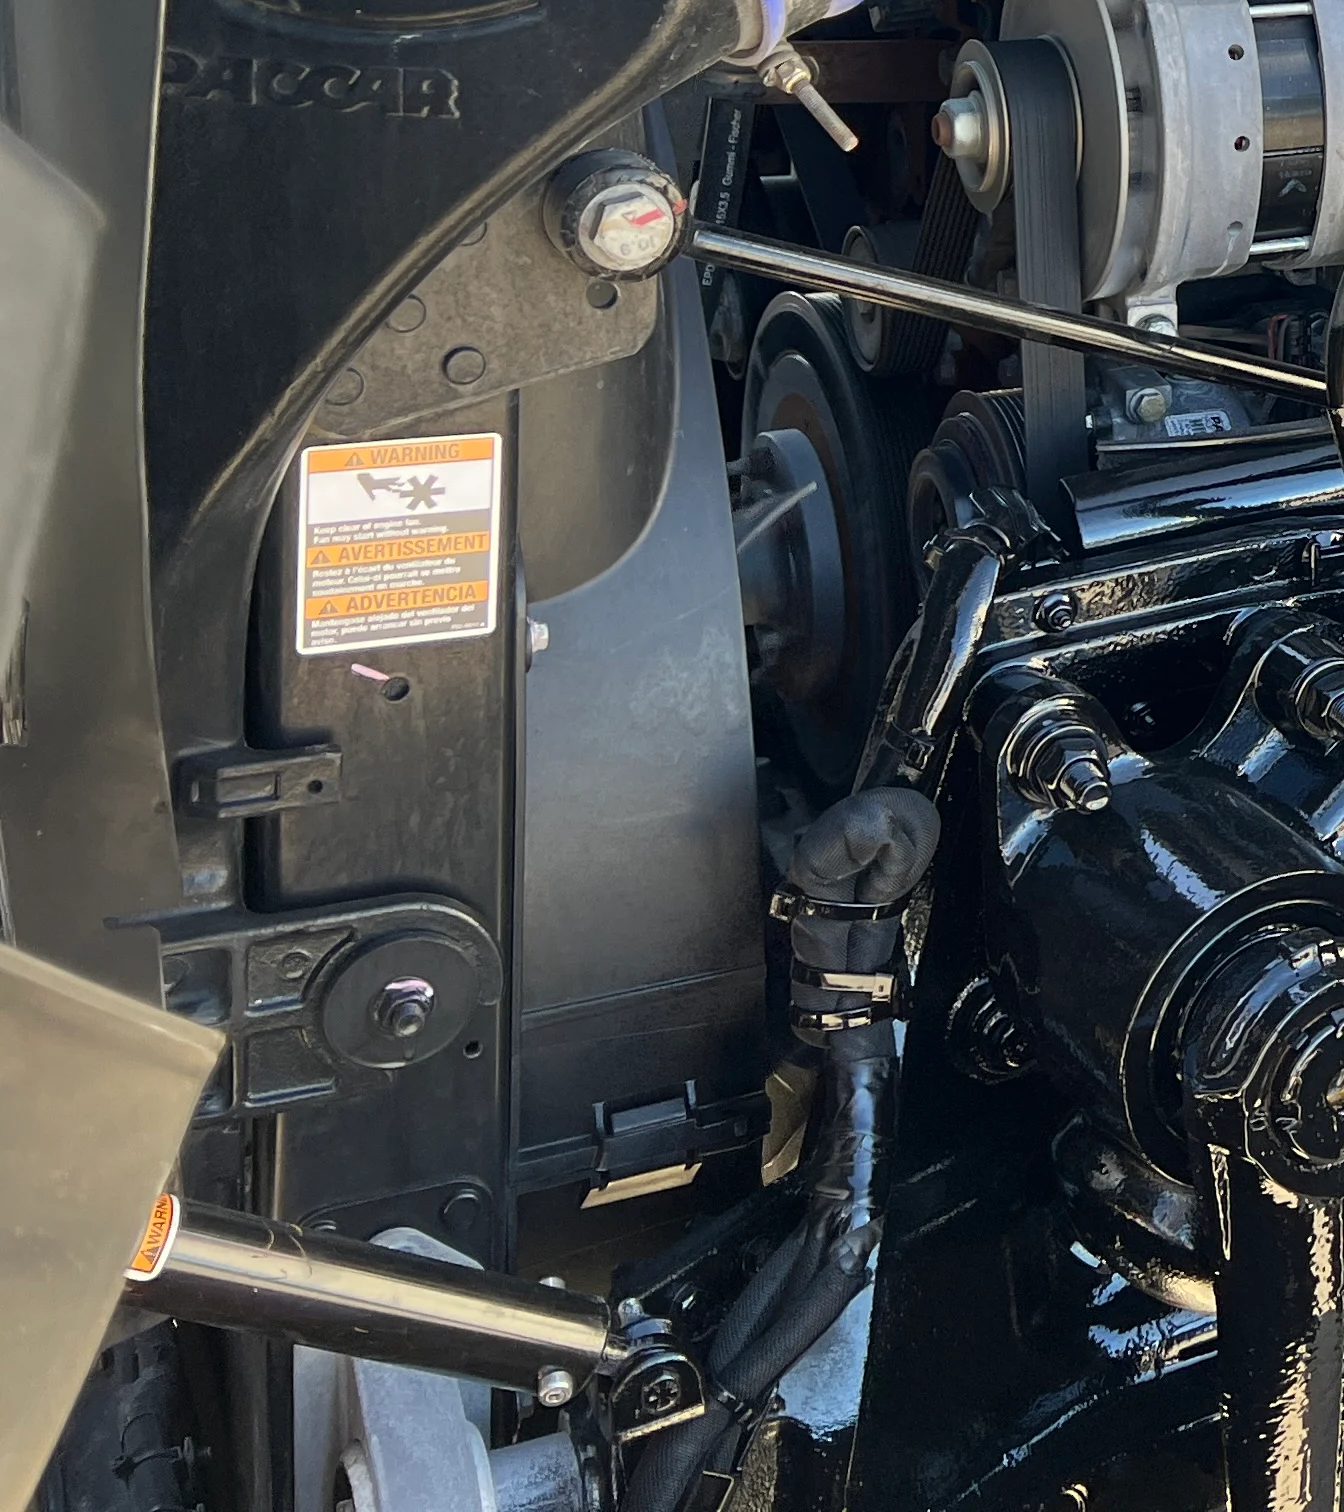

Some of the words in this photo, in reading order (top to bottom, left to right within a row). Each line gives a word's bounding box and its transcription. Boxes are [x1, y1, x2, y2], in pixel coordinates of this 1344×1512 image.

[162, 47, 460, 119] PACCAR
[370, 443, 461, 465] WARNING
[338, 534, 487, 562] AVERTISSEMENT
[346, 585, 476, 613] ADVERTENCIA
